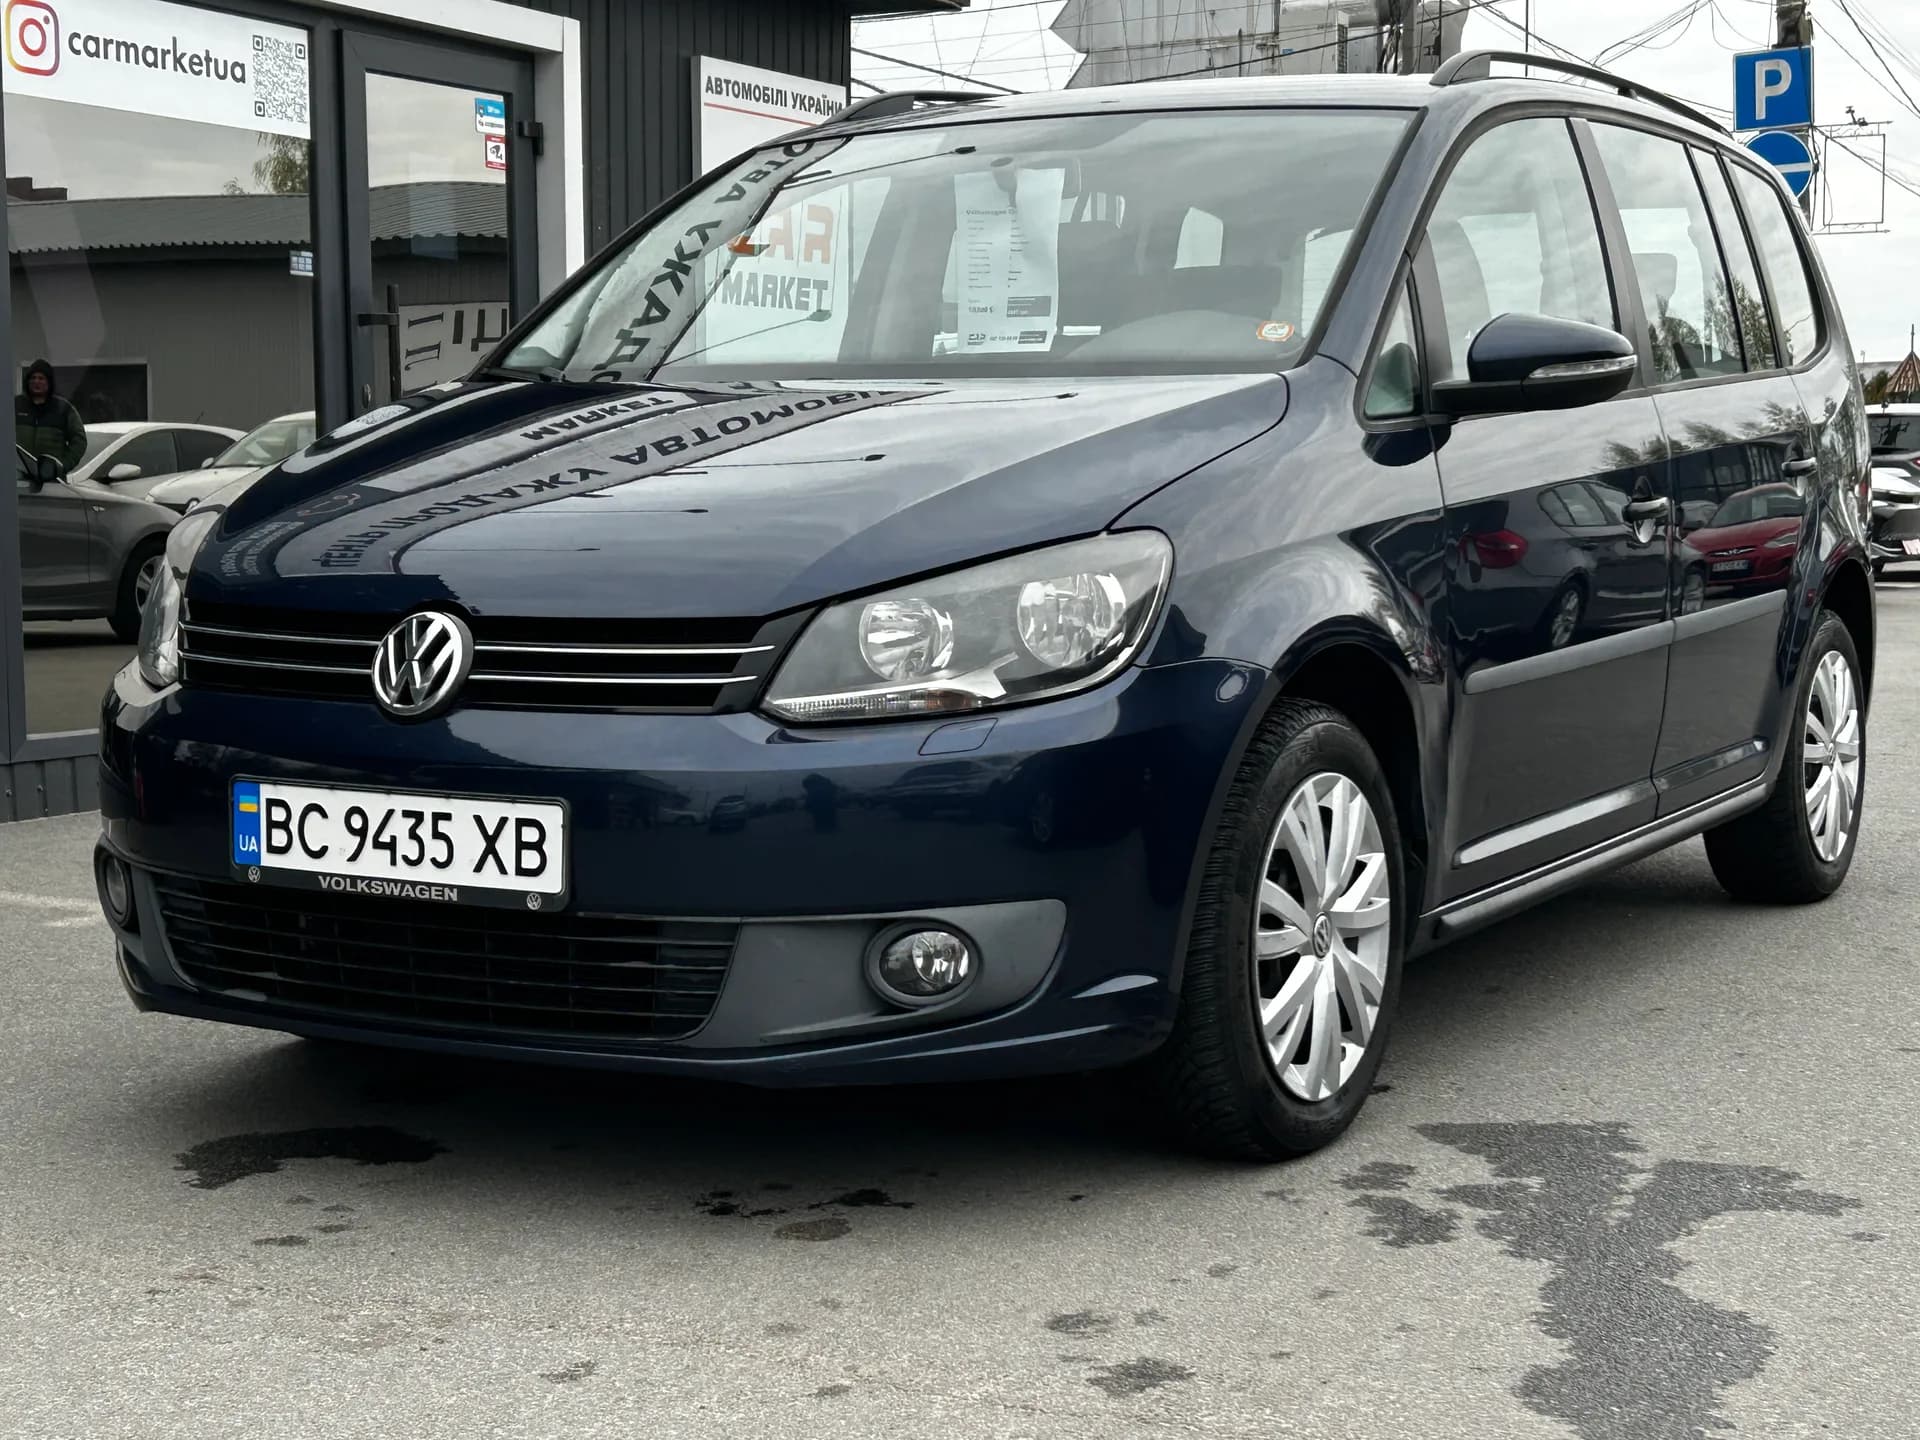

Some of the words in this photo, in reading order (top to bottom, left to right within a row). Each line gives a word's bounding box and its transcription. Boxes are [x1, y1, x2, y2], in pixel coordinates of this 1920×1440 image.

[68, 32, 246, 84] carmarketua
[705, 75, 788, 108] АВТОМОБІЛІ
[1755, 60, 1791, 120] P
[721, 271, 829, 311] MARKET
[239, 834, 258, 853] UA
[265, 797, 329, 860] BC
[344, 805, 454, 869] 9435
[472, 814, 548, 877] XB
[318, 875, 458, 901] VOLKSWAGEN
